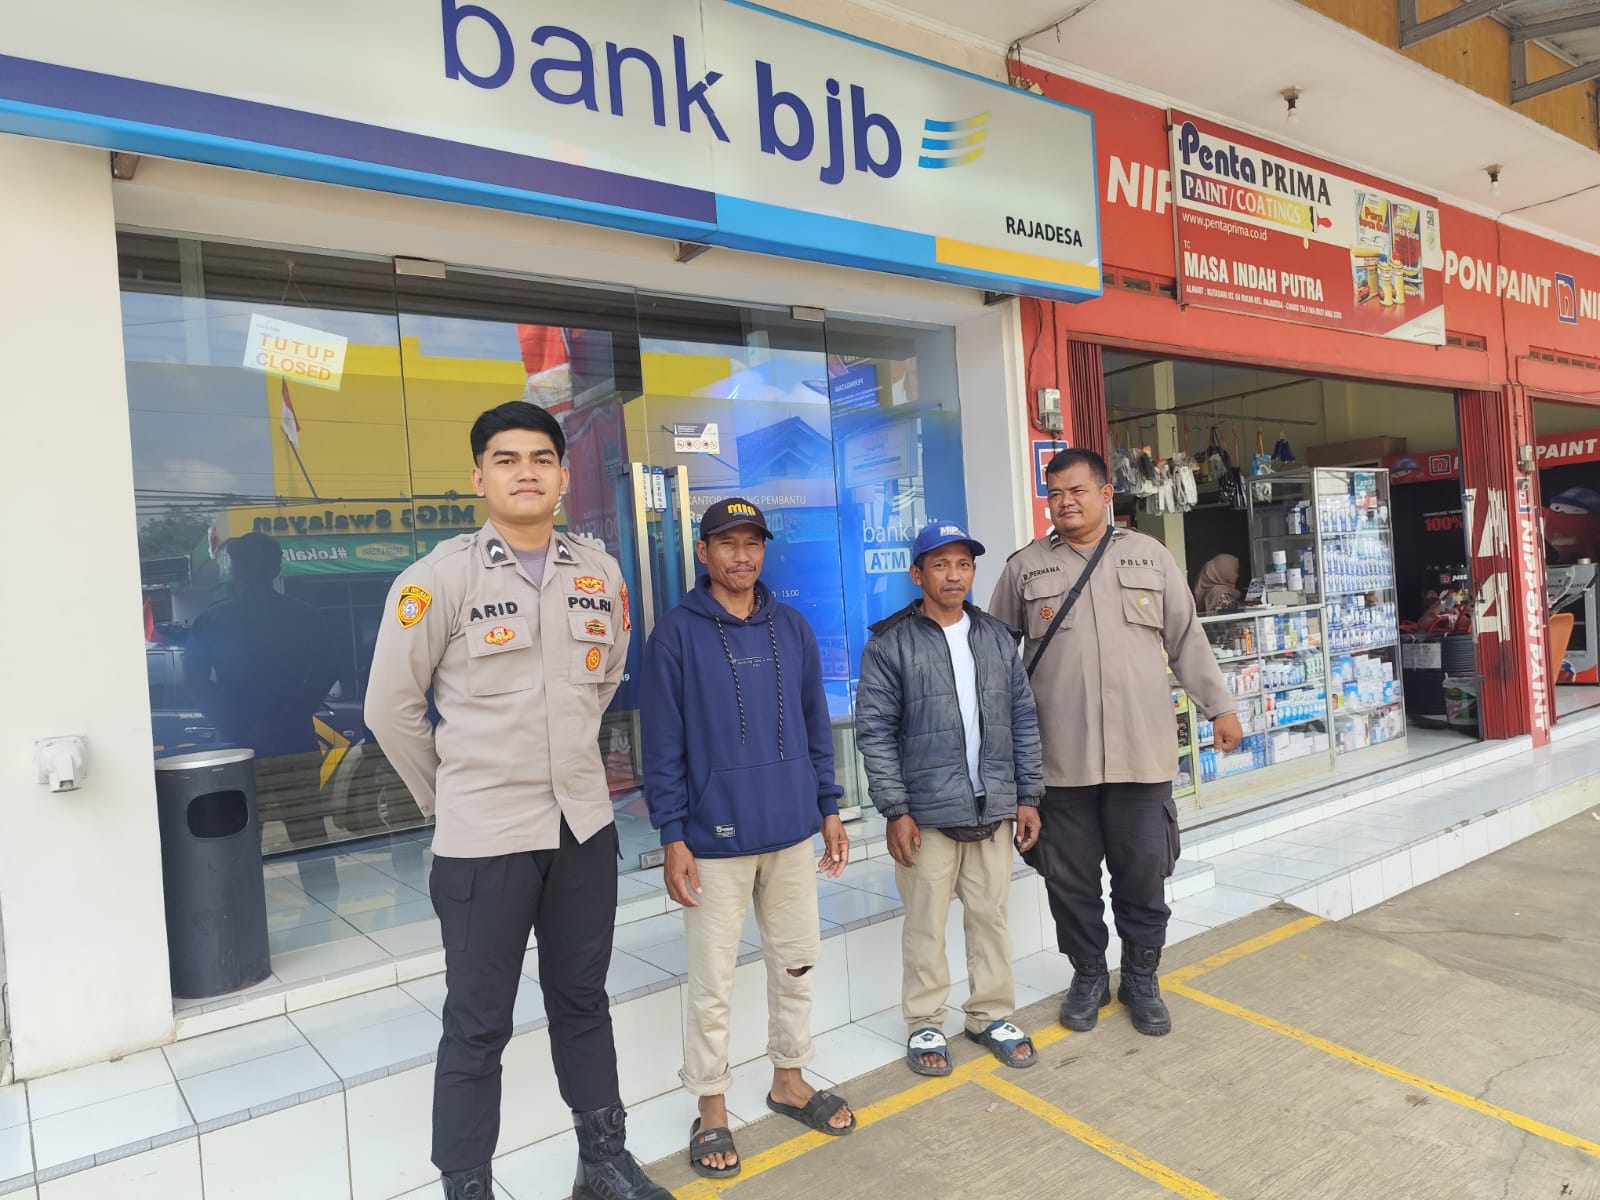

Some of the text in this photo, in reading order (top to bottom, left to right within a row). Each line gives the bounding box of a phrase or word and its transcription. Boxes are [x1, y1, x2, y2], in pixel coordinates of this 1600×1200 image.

[441, 0, 903, 186] bank bjb
[1178, 121, 1332, 206] Penta PRIMA
[1005, 215, 1083, 248] RAJADESA
[1182, 213, 1268, 241] www.pentaprima.co.id
[1184, 251, 1324, 302] MASA INDAH PUTRA
[1496, 265, 1552, 308] PAINT
[260, 332, 335, 362] TUTUP
[255, 352, 331, 381] CLOSED
[1535, 438, 1597, 460] PAINT
[761, 496, 806, 505] PEMBANTU
[863, 520, 910, 543] bank
[871, 551, 906, 570] ATM
[1120, 559, 1154, 567] POLRI
[470, 601, 518, 622] ARID
[568, 596, 611, 612] POLRI
[1520, 519, 1549, 730] NIPPON PAINT
